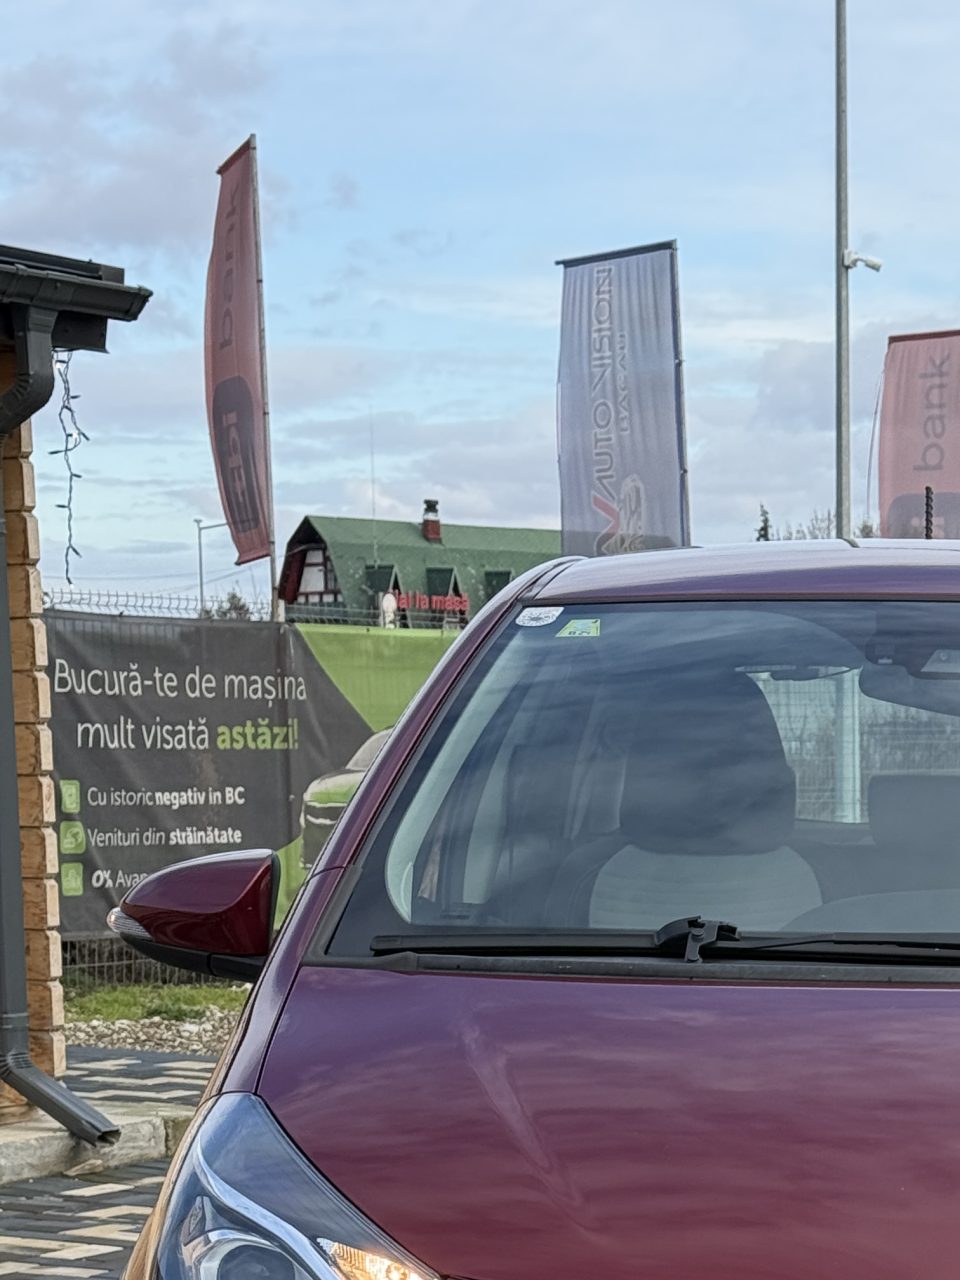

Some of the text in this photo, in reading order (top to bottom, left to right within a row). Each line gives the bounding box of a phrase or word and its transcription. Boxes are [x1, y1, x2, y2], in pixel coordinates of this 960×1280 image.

[591, 266, 614, 394] VISION
[913, 351, 951, 473] bank
[592, 400, 615, 501] AUTO
[53, 658, 307, 708] Bucură-te de mașina
[77, 715, 299, 750] mult visată astăzi!
[87, 786, 107, 806] Cu
[110, 787, 154, 806] istoric
[154, 786, 206, 811] negativ
[224, 786, 246, 805] BC
[87, 826, 243, 847] Venituri din străinătate
